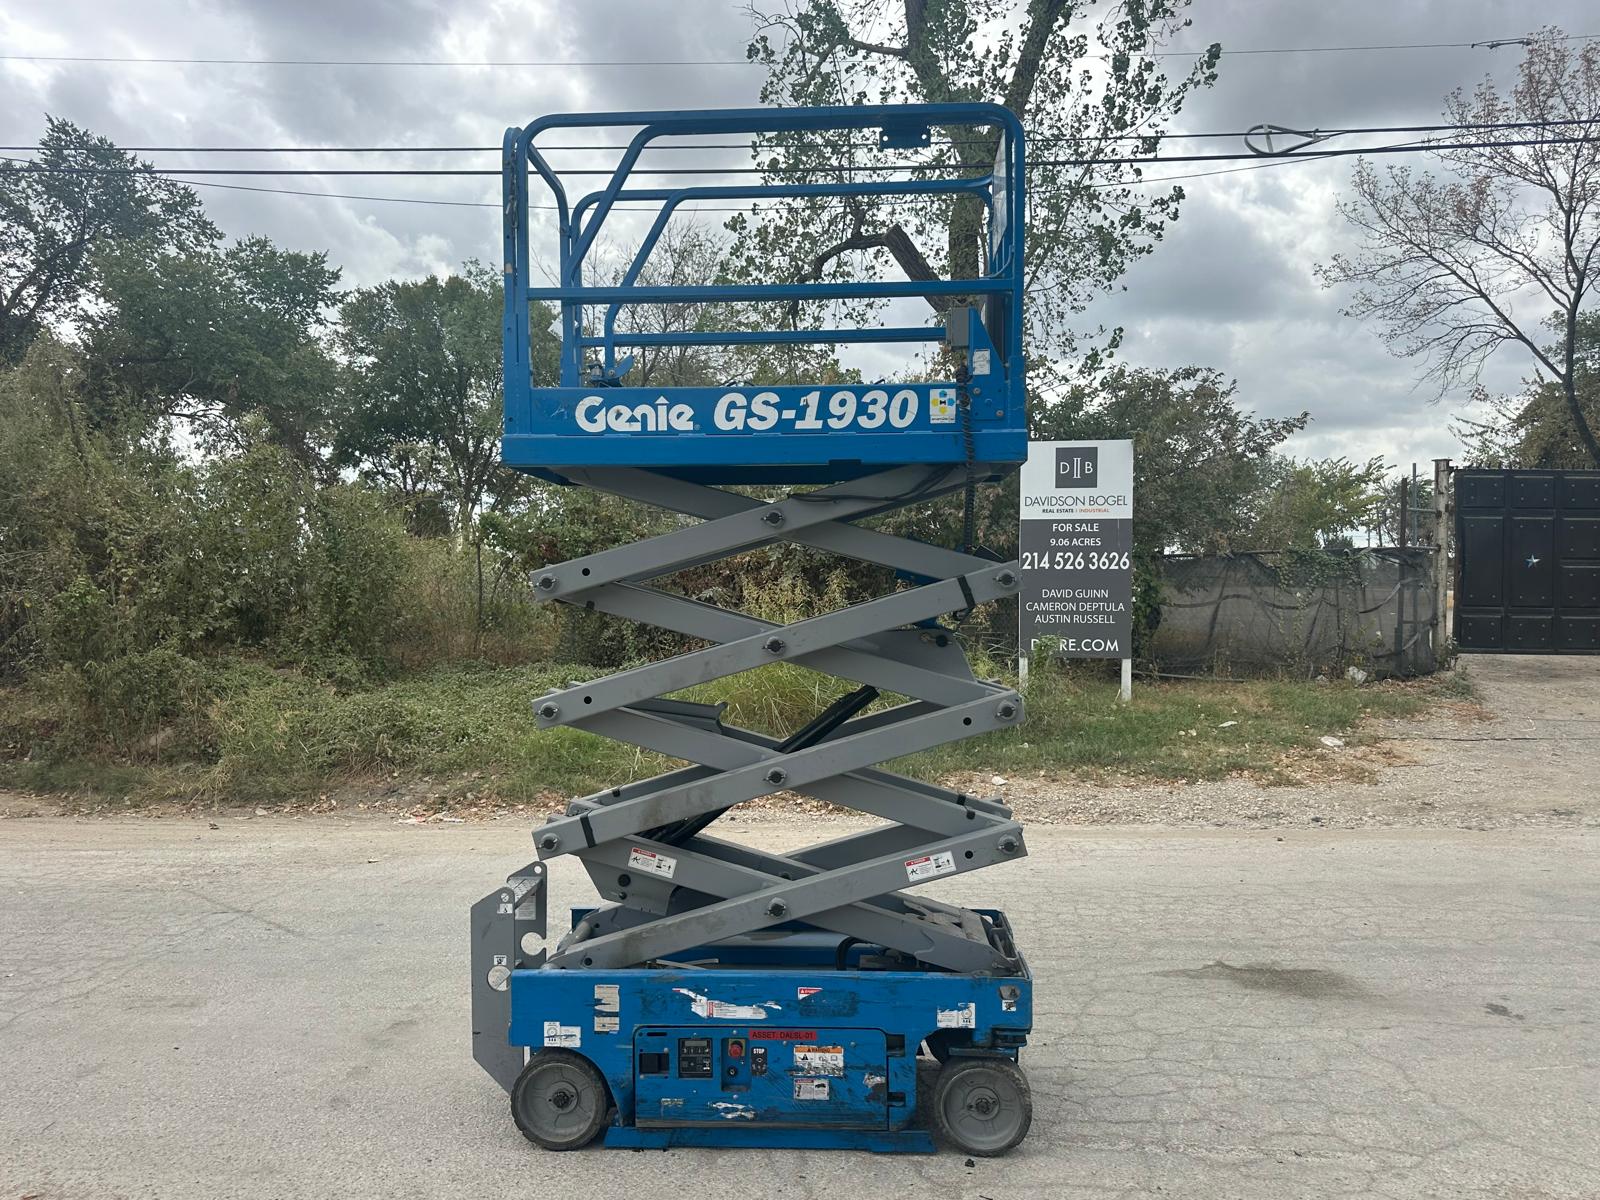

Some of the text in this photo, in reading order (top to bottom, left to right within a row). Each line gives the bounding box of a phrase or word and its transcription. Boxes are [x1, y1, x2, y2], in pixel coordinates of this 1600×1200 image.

[575, 389, 919, 433] Genie GS-1930
[1024, 495, 1128, 507] DAVIDSON BOGEL
[1052, 523, 1100, 532] FOR SALE
[1050, 537, 1102, 547] 9.06 ACRES
[1022, 551, 1130, 570] 214 526 3626
[1042, 589, 1109, 598] DAVID GUINN
[1025, 602, 1125, 612] CAMERON DEPTULA
[1034, 614, 1116, 624] AUSTIN RUSSELL
